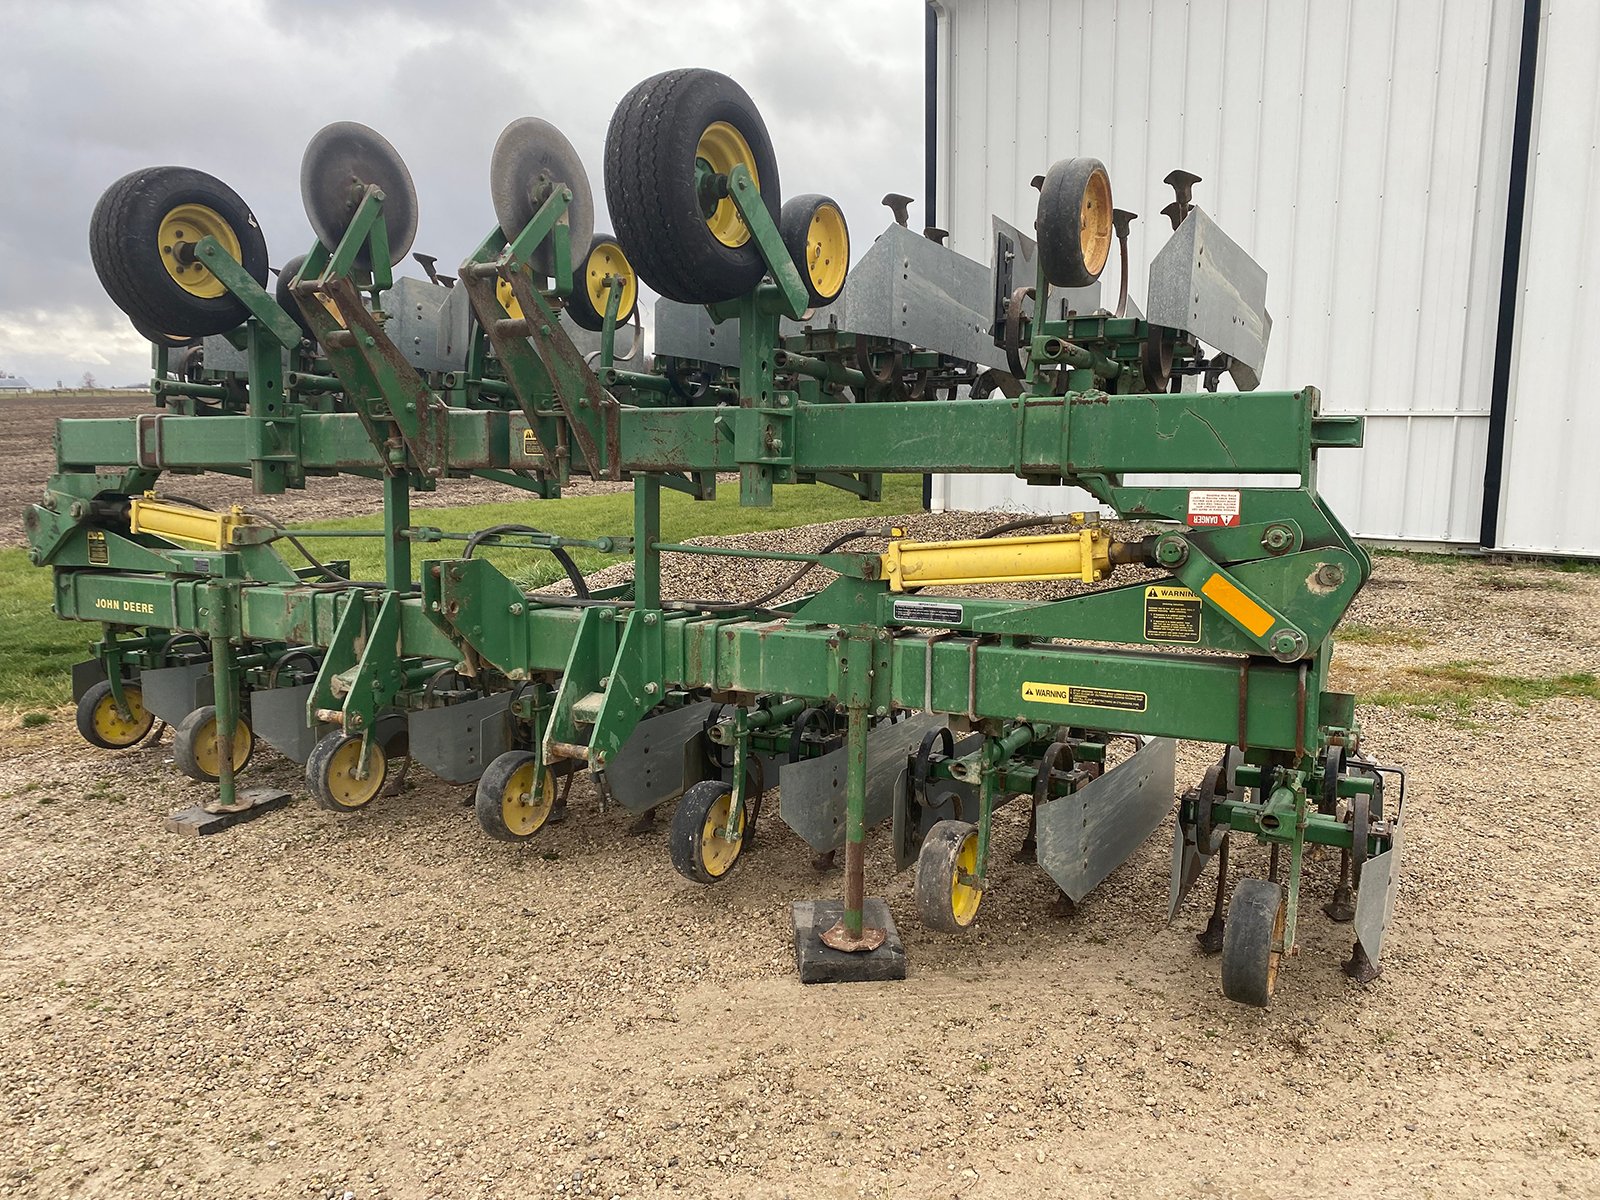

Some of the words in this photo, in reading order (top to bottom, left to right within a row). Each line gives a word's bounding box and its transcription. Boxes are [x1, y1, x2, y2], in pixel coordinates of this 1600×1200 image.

[1193, 515, 1219, 524] DANGER
[95, 598, 120, 610] JOHN
[123, 600, 154, 614] DEERE
[1035, 688, 1067, 699] WARNING
